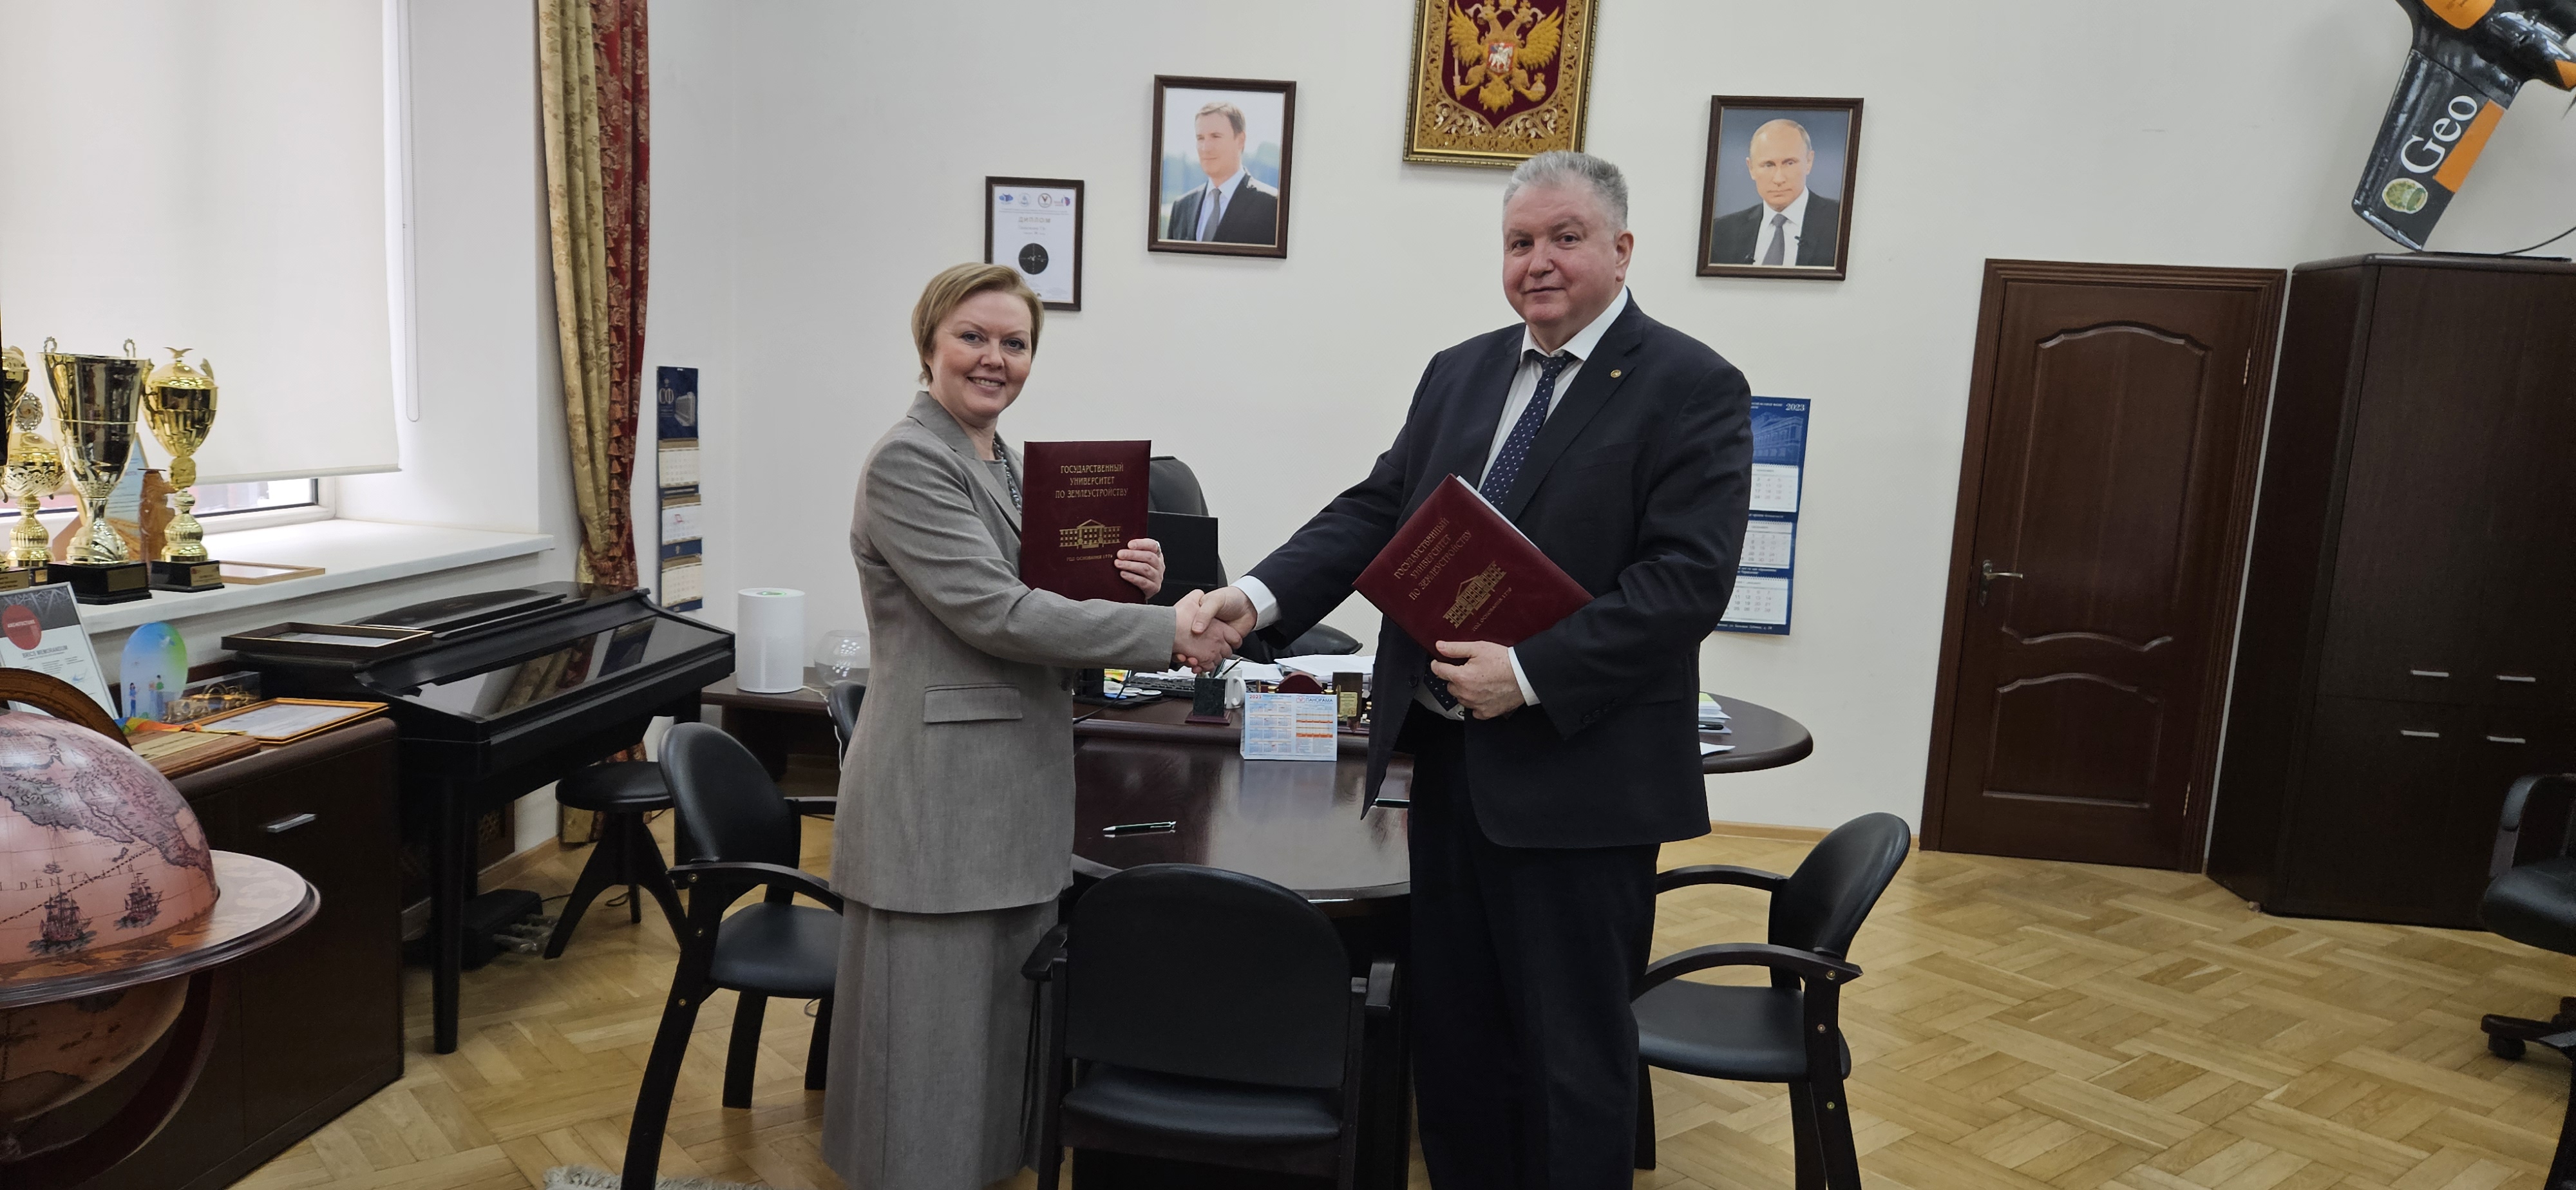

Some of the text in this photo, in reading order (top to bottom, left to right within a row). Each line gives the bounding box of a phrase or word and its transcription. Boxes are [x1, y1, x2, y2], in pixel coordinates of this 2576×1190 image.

[2401, 95, 2477, 173] Geo
[1060, 462, 1124, 473] ГОСУДАРСТВЕННЫЙ
[1070, 477, 1115, 486] УНИВЕРСИТЕТ
[1067, 487, 1128, 498] ЗЕМЛЕУСТРОЙСТВУ
[1394, 517, 1450, 579] ГОСУДАРСТВЕННЫЙ
[1408, 529, 1472, 600] ПО ЗЕМЛЕУСТРОЙСТВУ
[1410, 534, 1451, 579] УНИВЕРСИТЕТ
